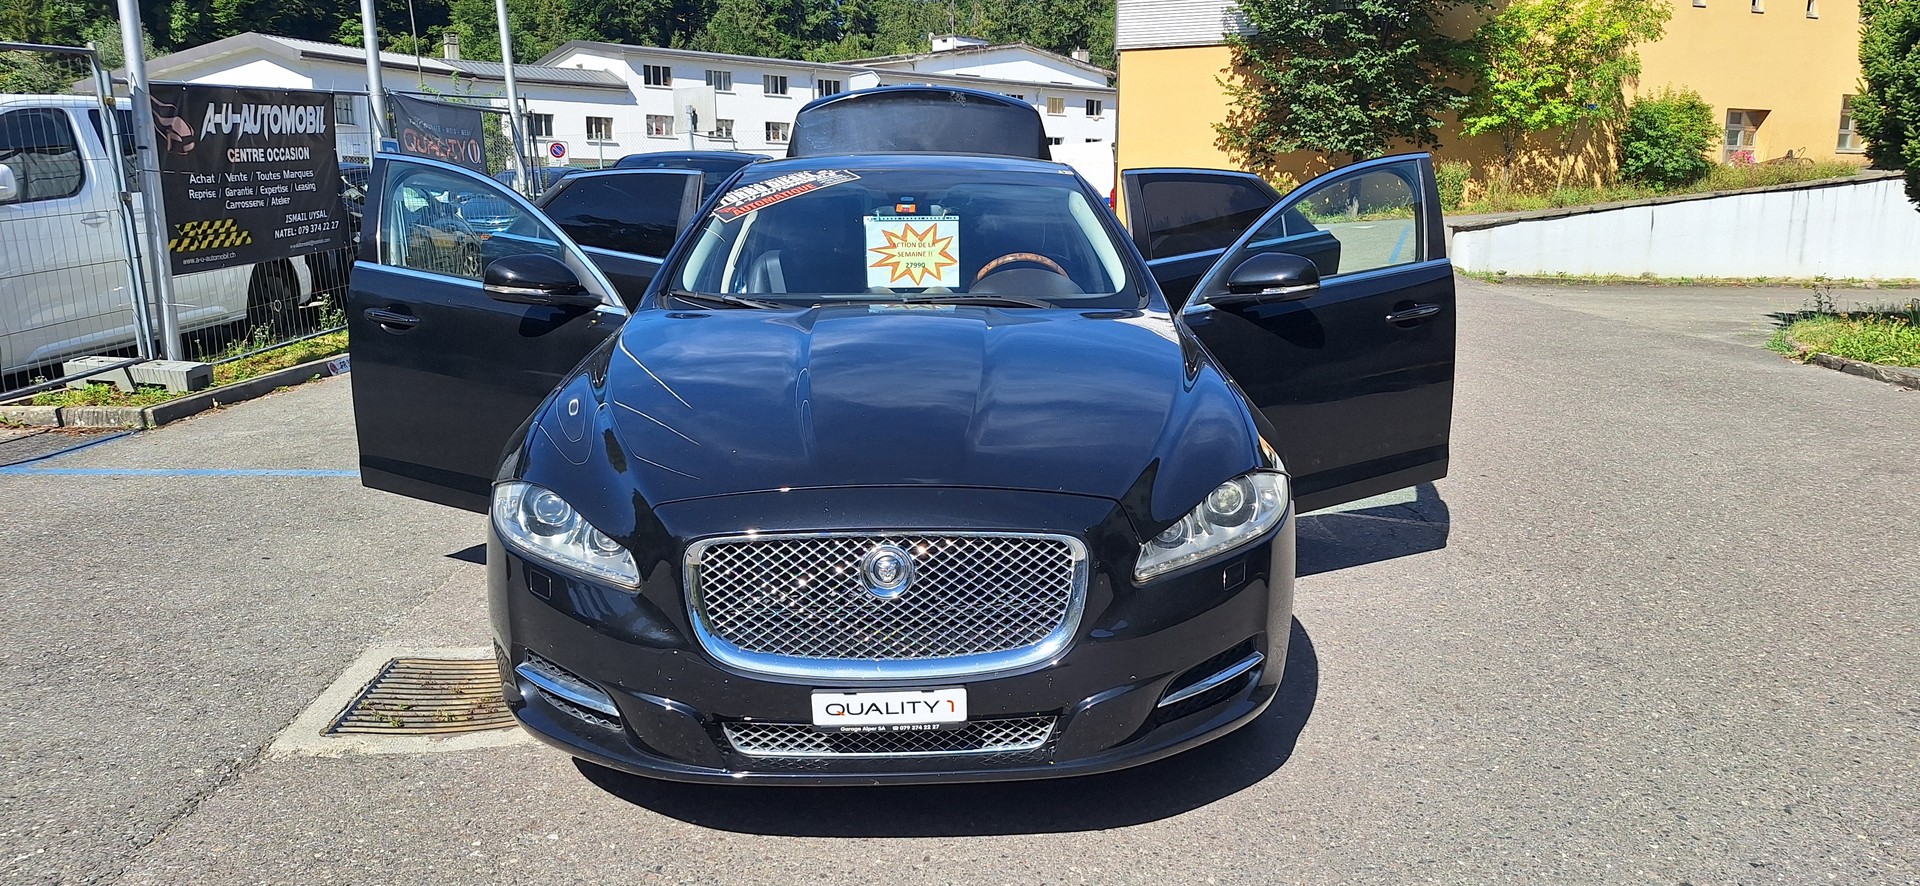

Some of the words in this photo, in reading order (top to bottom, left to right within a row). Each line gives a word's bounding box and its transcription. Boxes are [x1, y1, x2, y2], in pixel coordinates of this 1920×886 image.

[200, 103, 327, 142] A-U-AUTOMOBIL
[227, 148, 265, 163] CENTRE
[267, 147, 310, 162] OCCASION
[189, 173, 216, 184] Achat
[225, 172, 248, 183] Vente
[256, 170, 281, 181] Toutes
[283, 169, 314, 180] Marques
[188, 189, 217, 200] Reprise
[225, 186, 254, 197] Garantie
[260, 183, 289, 196] Expertise
[294, 181, 317, 192] Leasing
[225, 199, 265, 210] Carrosserie
[271, 196, 291, 206] Atelier
[732, 183, 817, 216] AUTOMATIQUE
[285, 212, 307, 224] ISMAIL
[308, 209, 328, 221] UYSAL
[274, 227, 297, 239] NATEL:
[298, 225, 309, 235] 079
[310, 223, 321, 233] 374
[322, 222, 330, 231] 22
[331, 221, 339, 229] 27
[825, 700, 940, 716] QUALITY
[946, 700, 955, 713] 1
